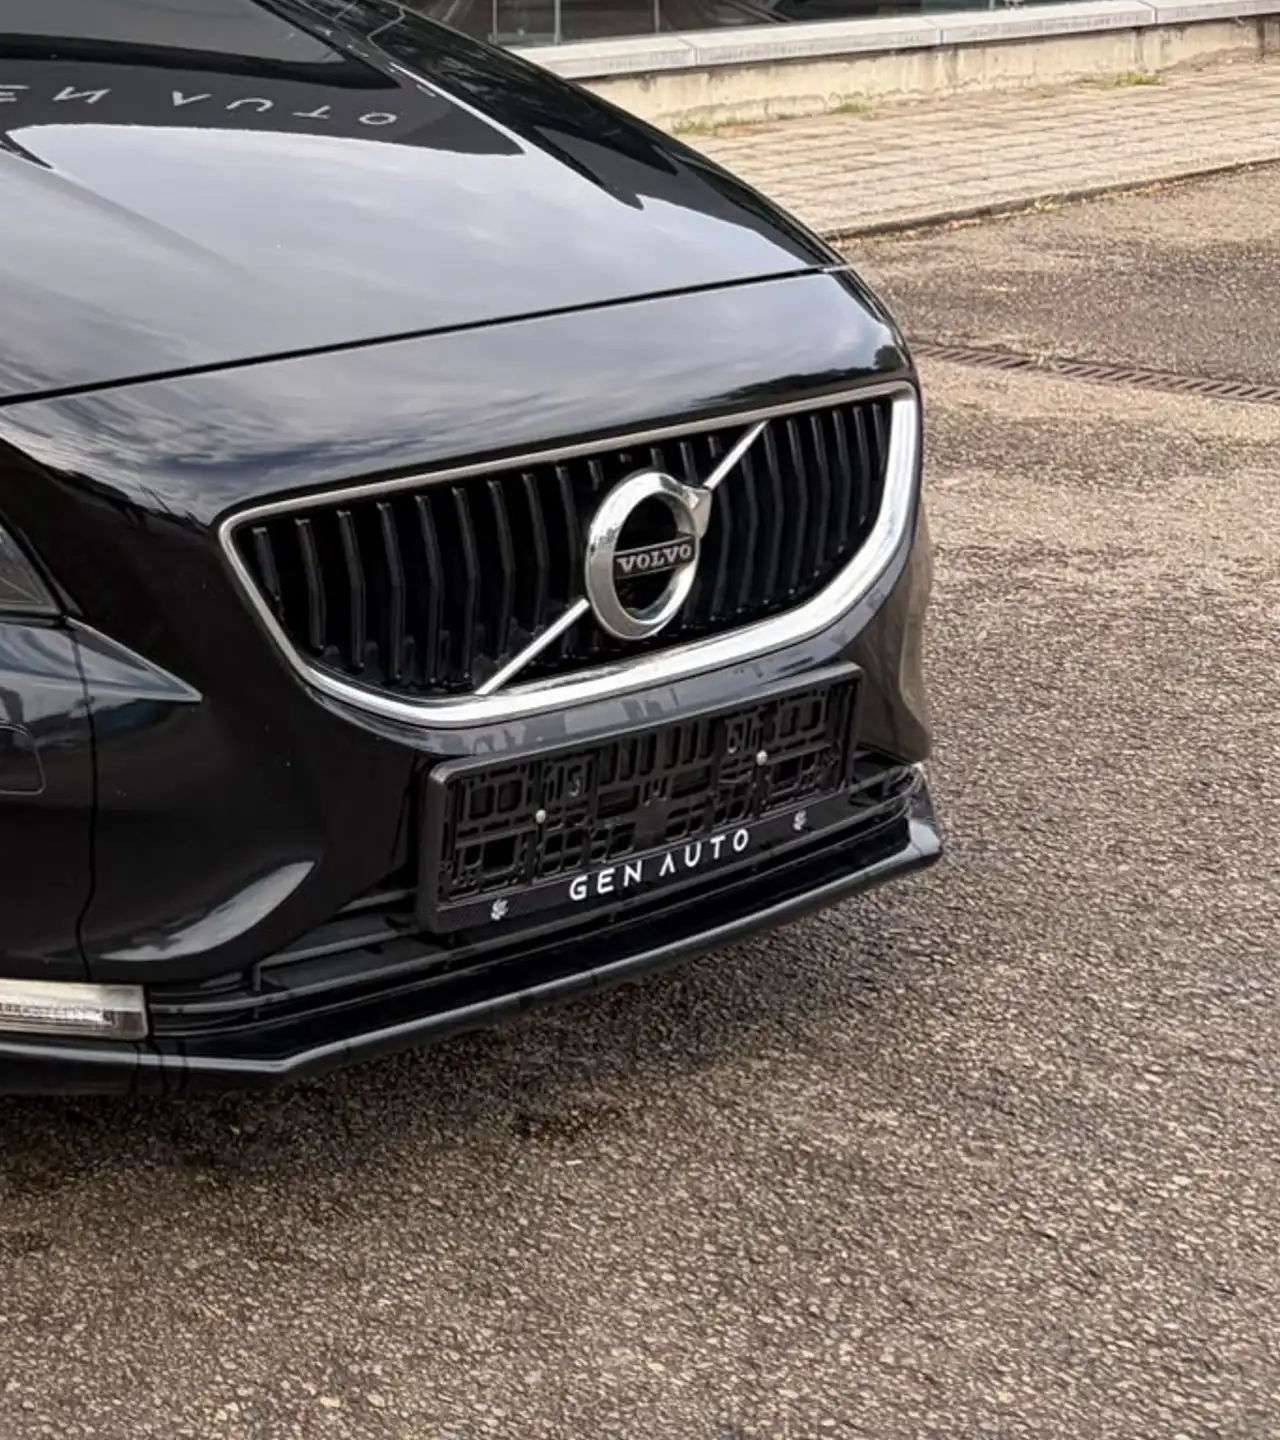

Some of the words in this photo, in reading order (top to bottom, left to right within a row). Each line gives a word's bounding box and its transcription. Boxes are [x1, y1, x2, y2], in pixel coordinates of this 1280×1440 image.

[616, 544, 692, 573] VOLVO
[569, 860, 642, 901] GEN
[659, 828, 749, 877] AUTO
